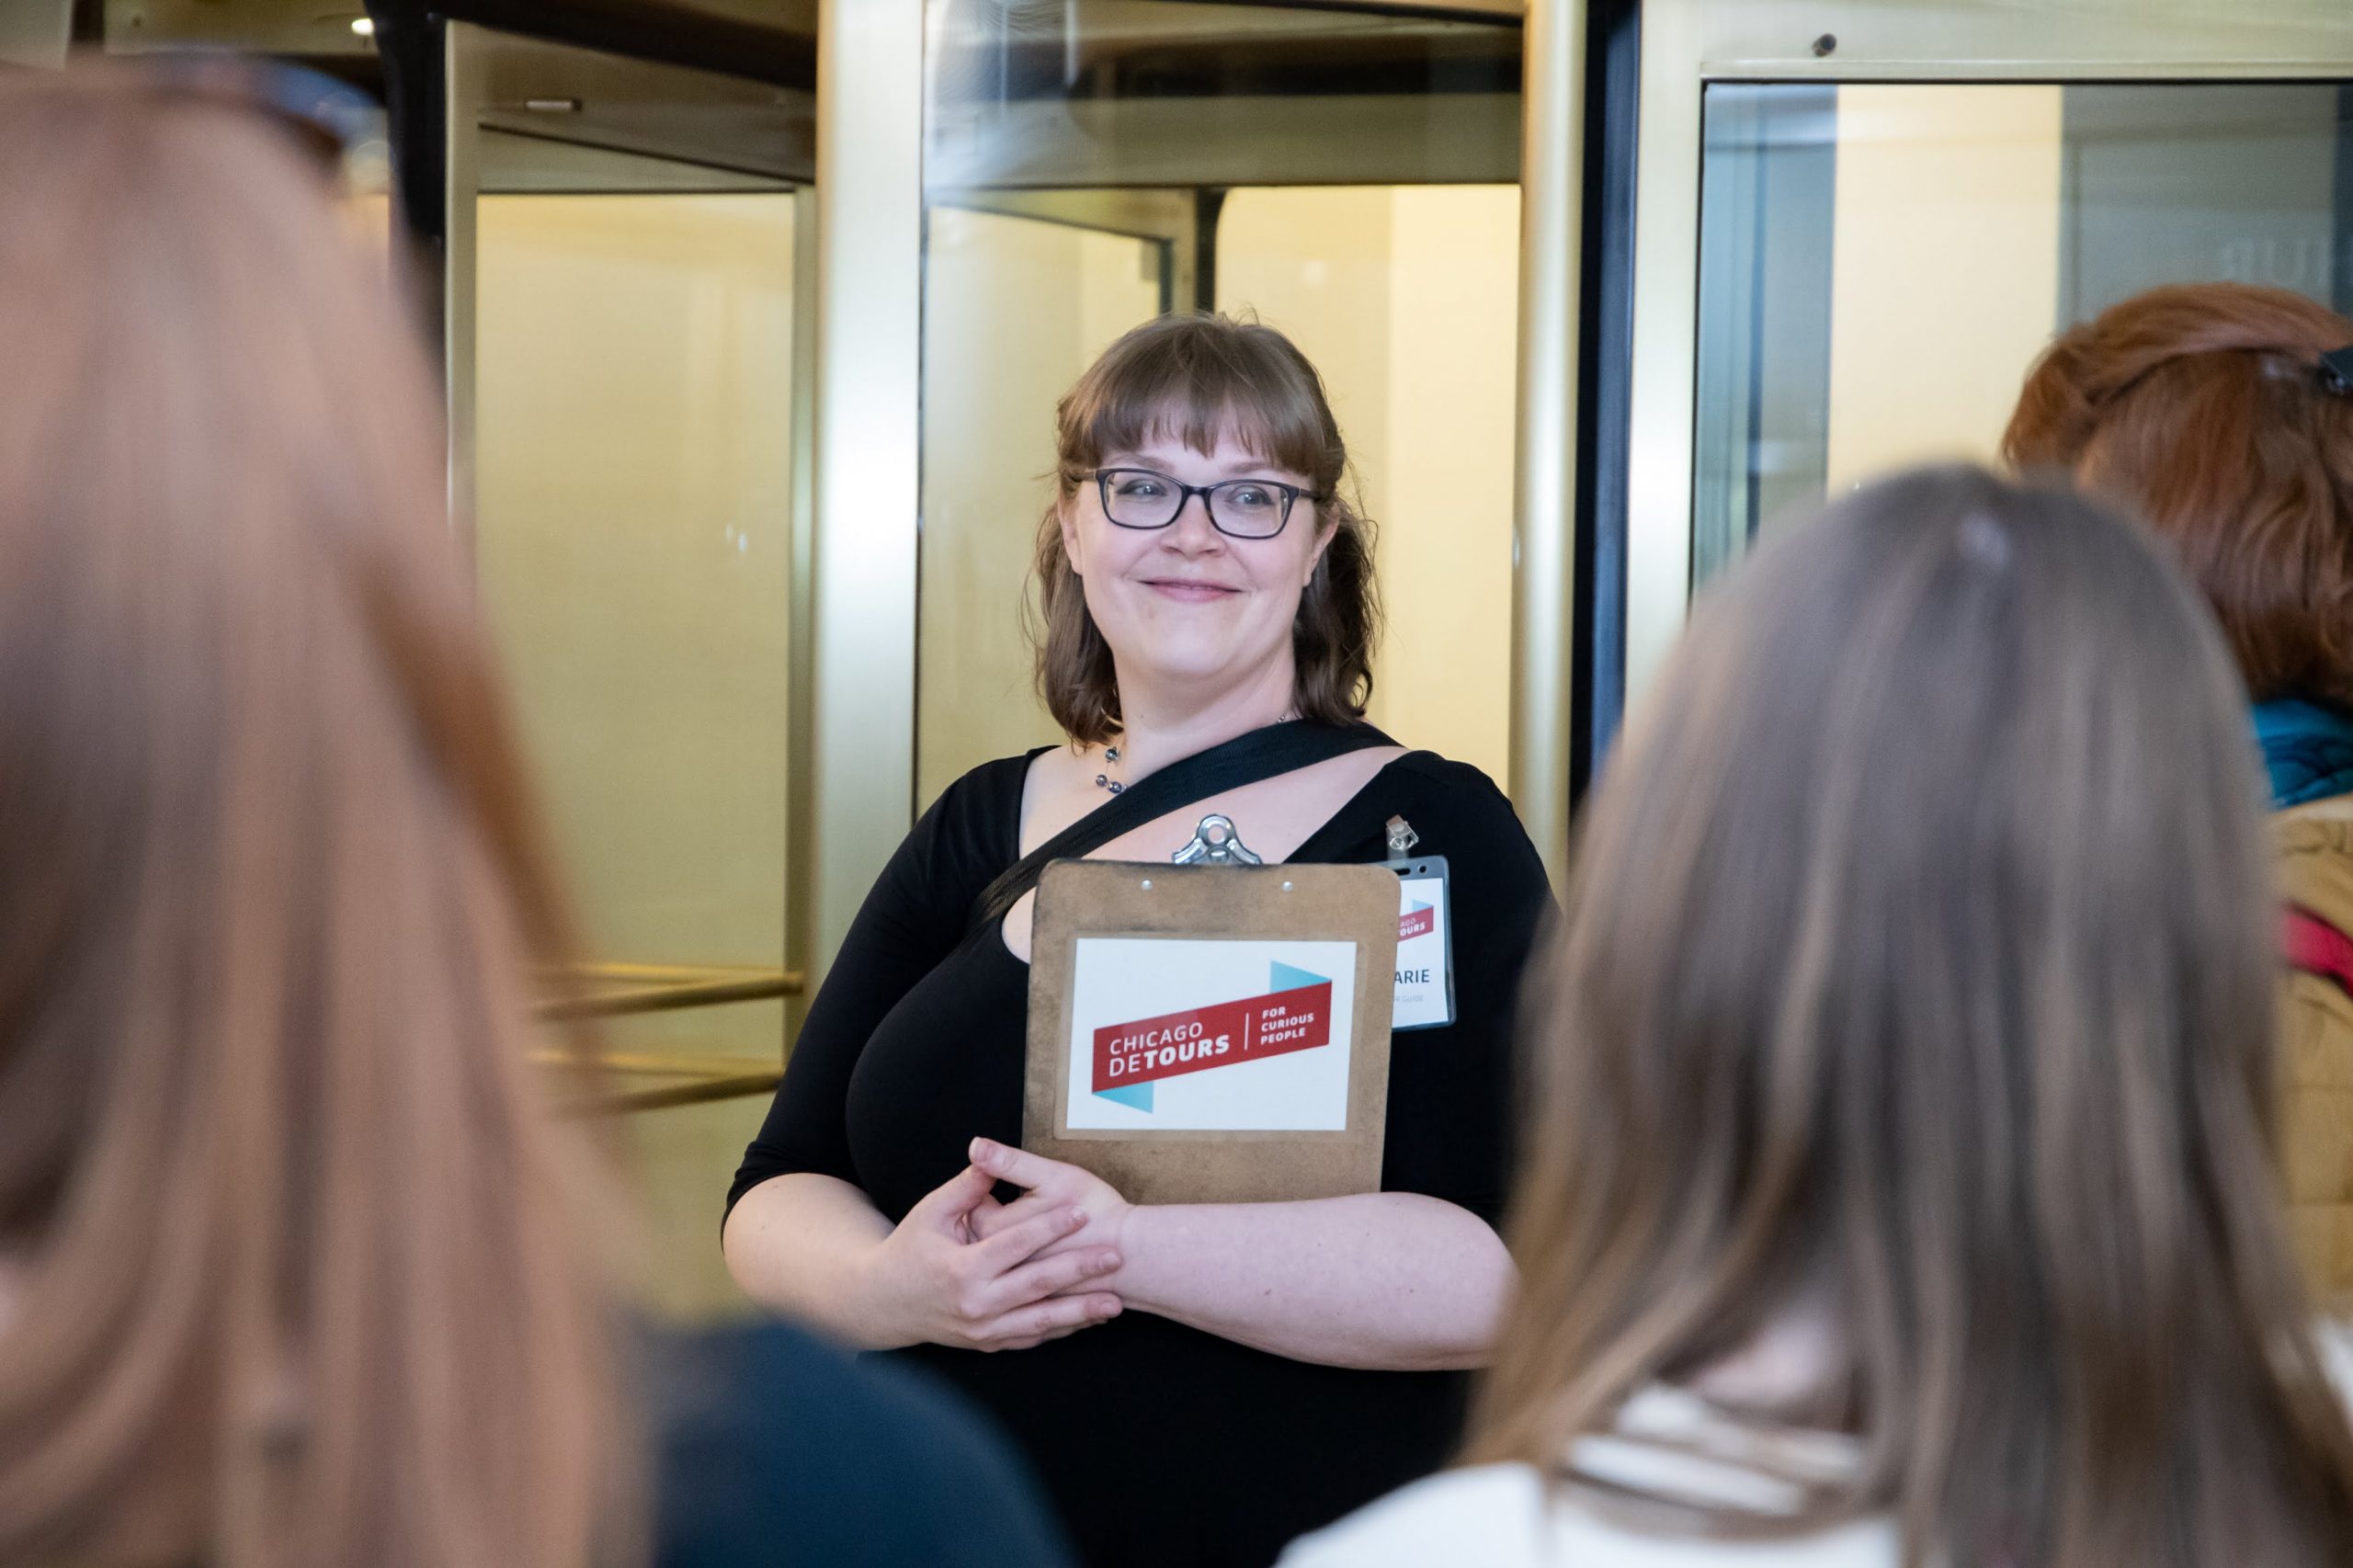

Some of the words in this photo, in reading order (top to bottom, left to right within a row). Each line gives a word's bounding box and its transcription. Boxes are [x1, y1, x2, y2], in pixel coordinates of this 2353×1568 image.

[1398, 922, 1426, 937] OURS
[1394, 970, 1430, 984] ARIE
[1262, 1006, 1287, 1019] FOR
[1260, 1013, 1314, 1032] CURIOUS
[1109, 1022, 1203, 1055] CHICAGO
[1260, 1027, 1306, 1045] PEOPLE
[1108, 1035, 1230, 1077] DETOURS
